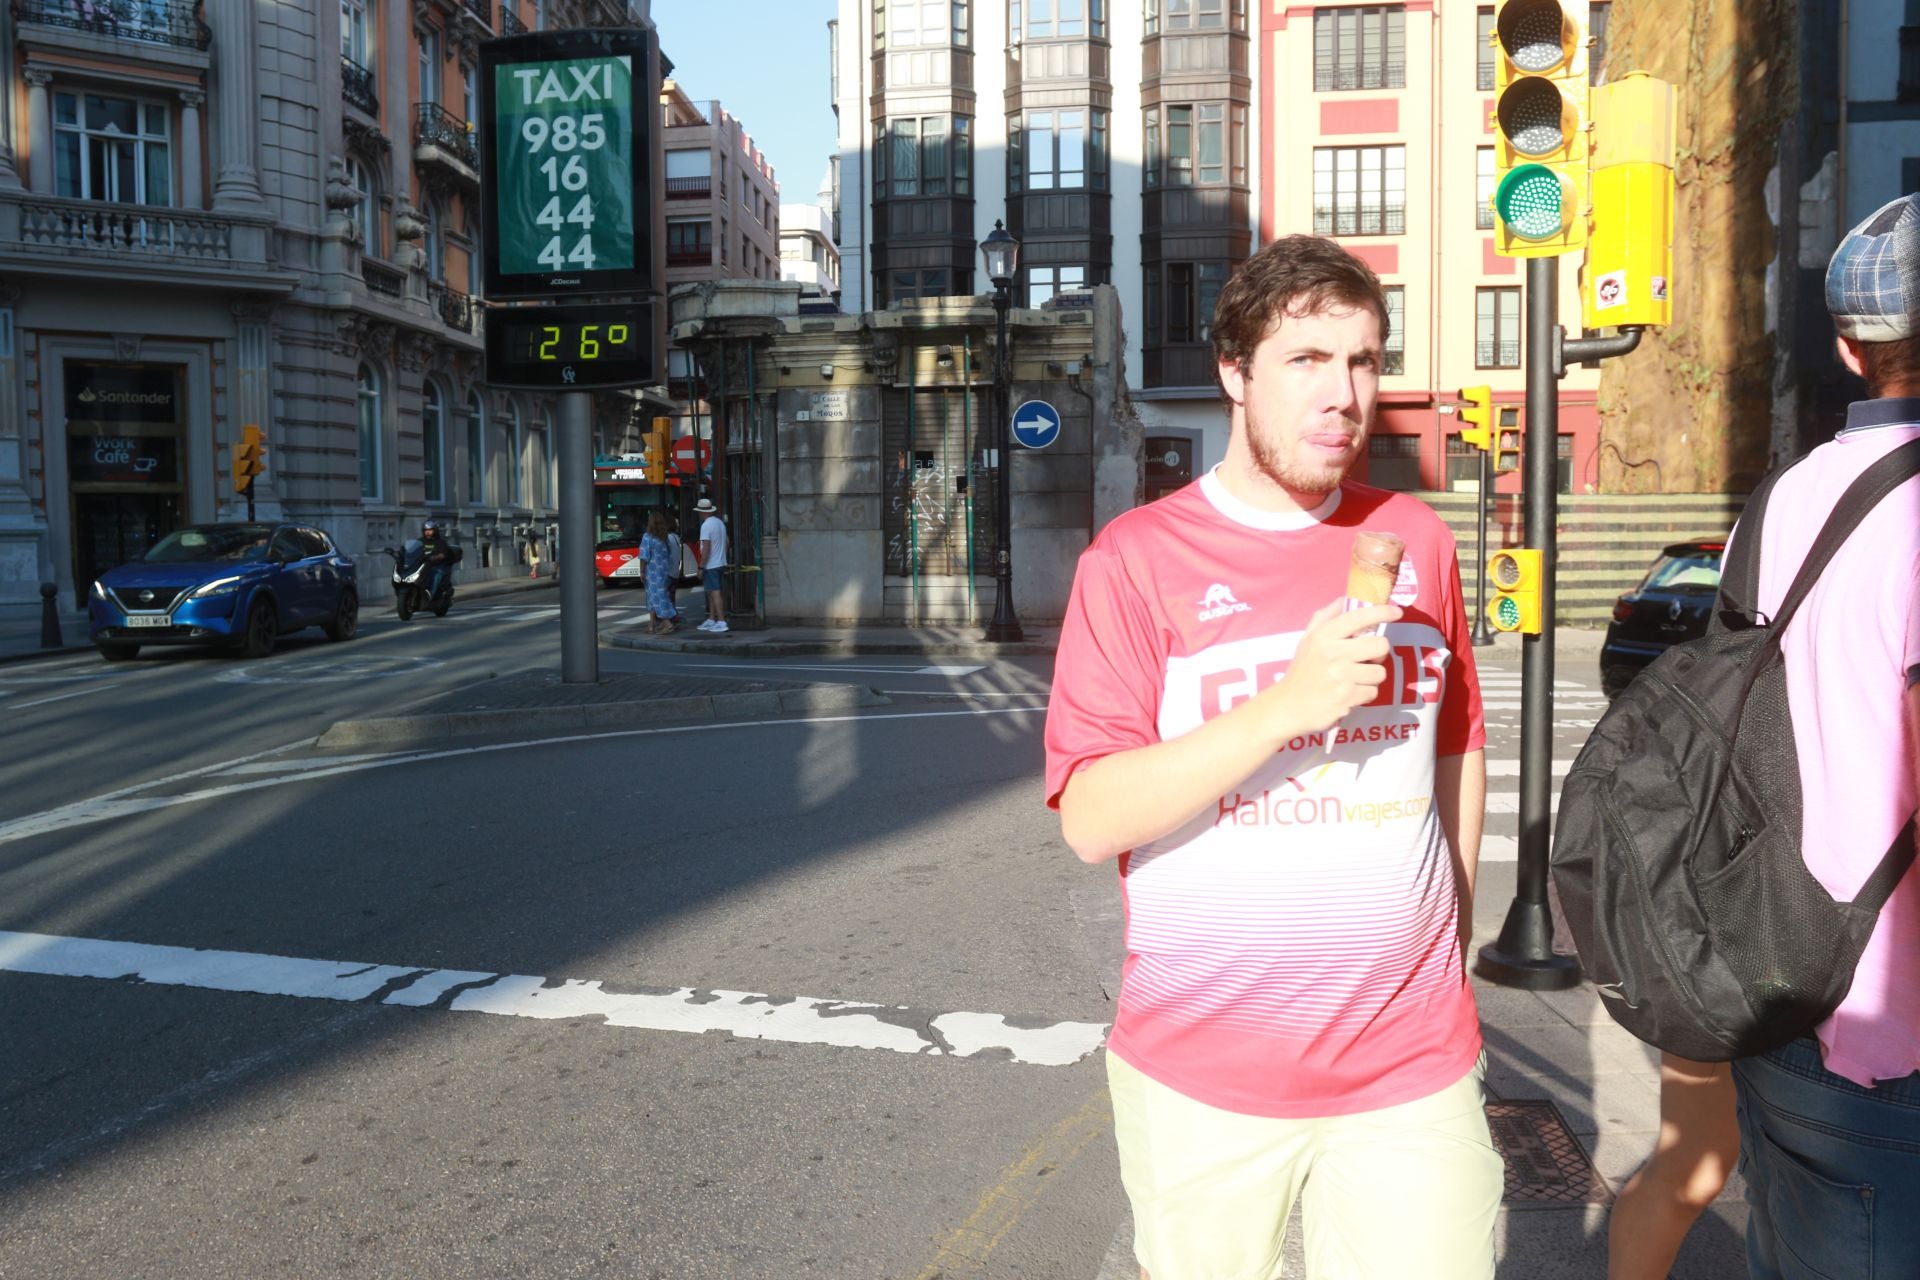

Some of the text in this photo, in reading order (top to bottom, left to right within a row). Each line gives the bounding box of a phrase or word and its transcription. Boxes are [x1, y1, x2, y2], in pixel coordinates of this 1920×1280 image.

[513, 63, 613, 105] TAXI
[522, 114, 606, 154] 985
[540, 154, 588, 192] 16
[536, 194, 596, 232] 44
[537, 234, 596, 271] 44
[550, 278, 581, 286] JCDecaux
[98, 390, 171, 404] Santander
[95, 437, 135, 449] Work
[95, 449, 129, 464] Café
[1334, 722, 1420, 744] BASKET
